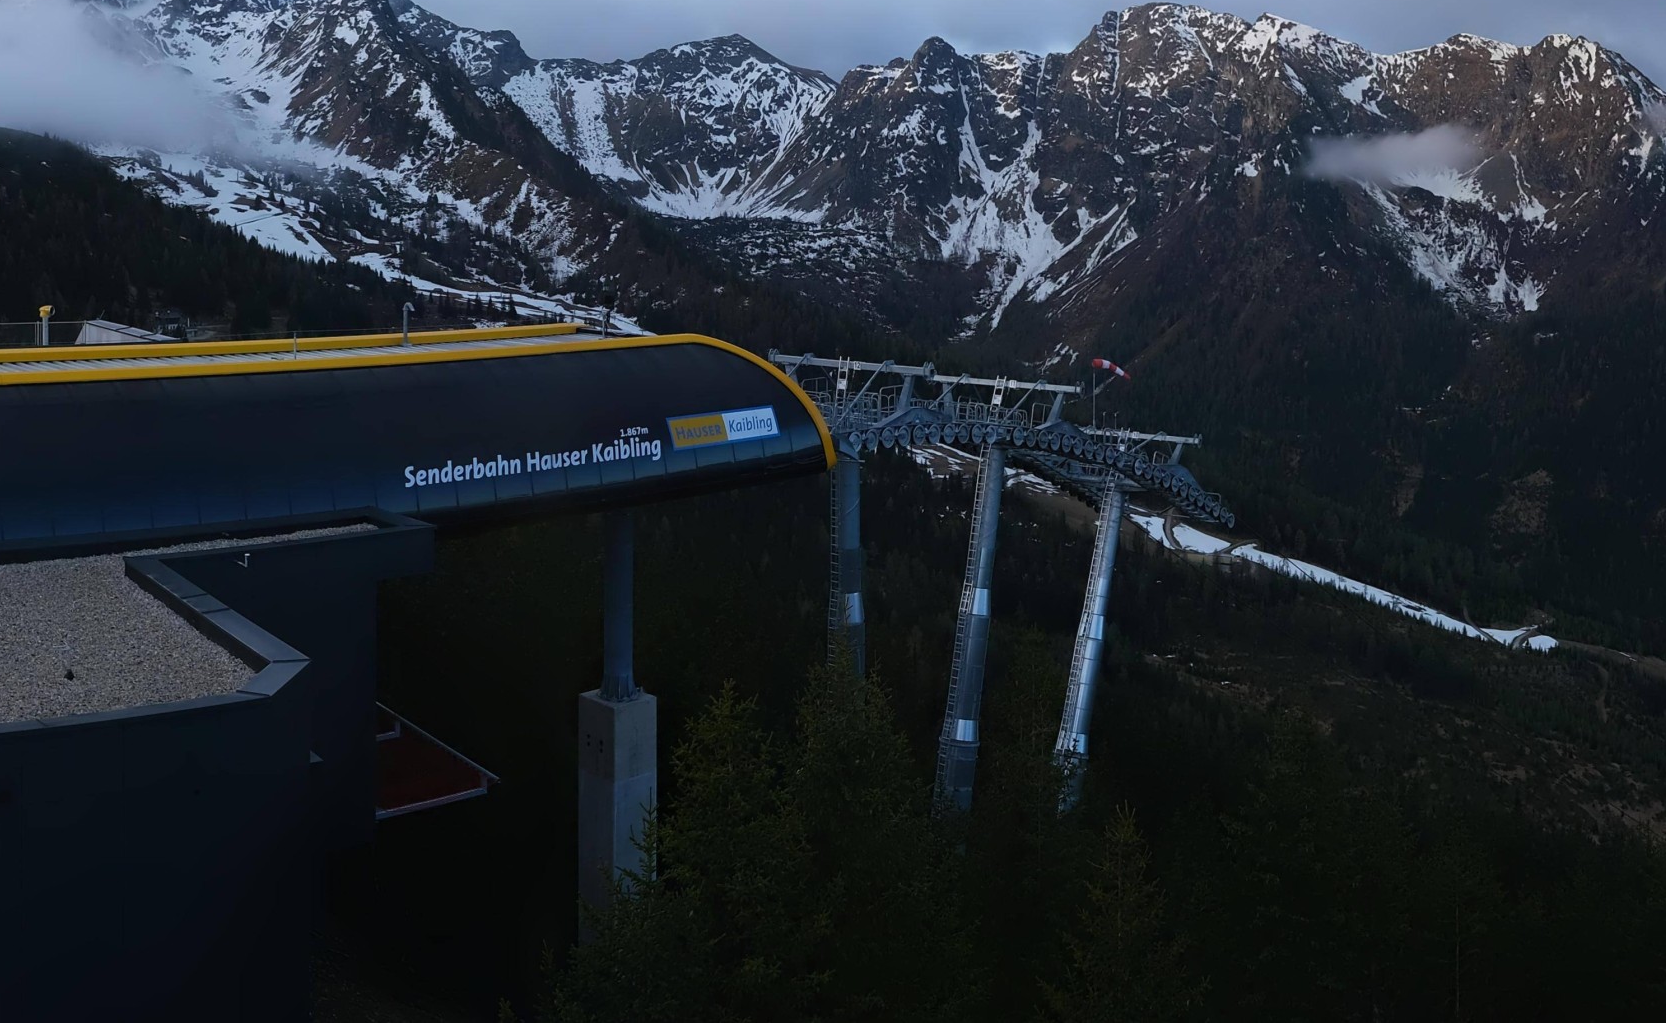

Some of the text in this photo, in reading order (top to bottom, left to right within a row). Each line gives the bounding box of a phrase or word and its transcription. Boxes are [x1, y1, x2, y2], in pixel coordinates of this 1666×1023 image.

[619, 425, 649, 438] 1.867m
[675, 414, 773, 441] HAUSER Kaibling
[403, 436, 661, 488] Senderbahn Hauser Kaibling
